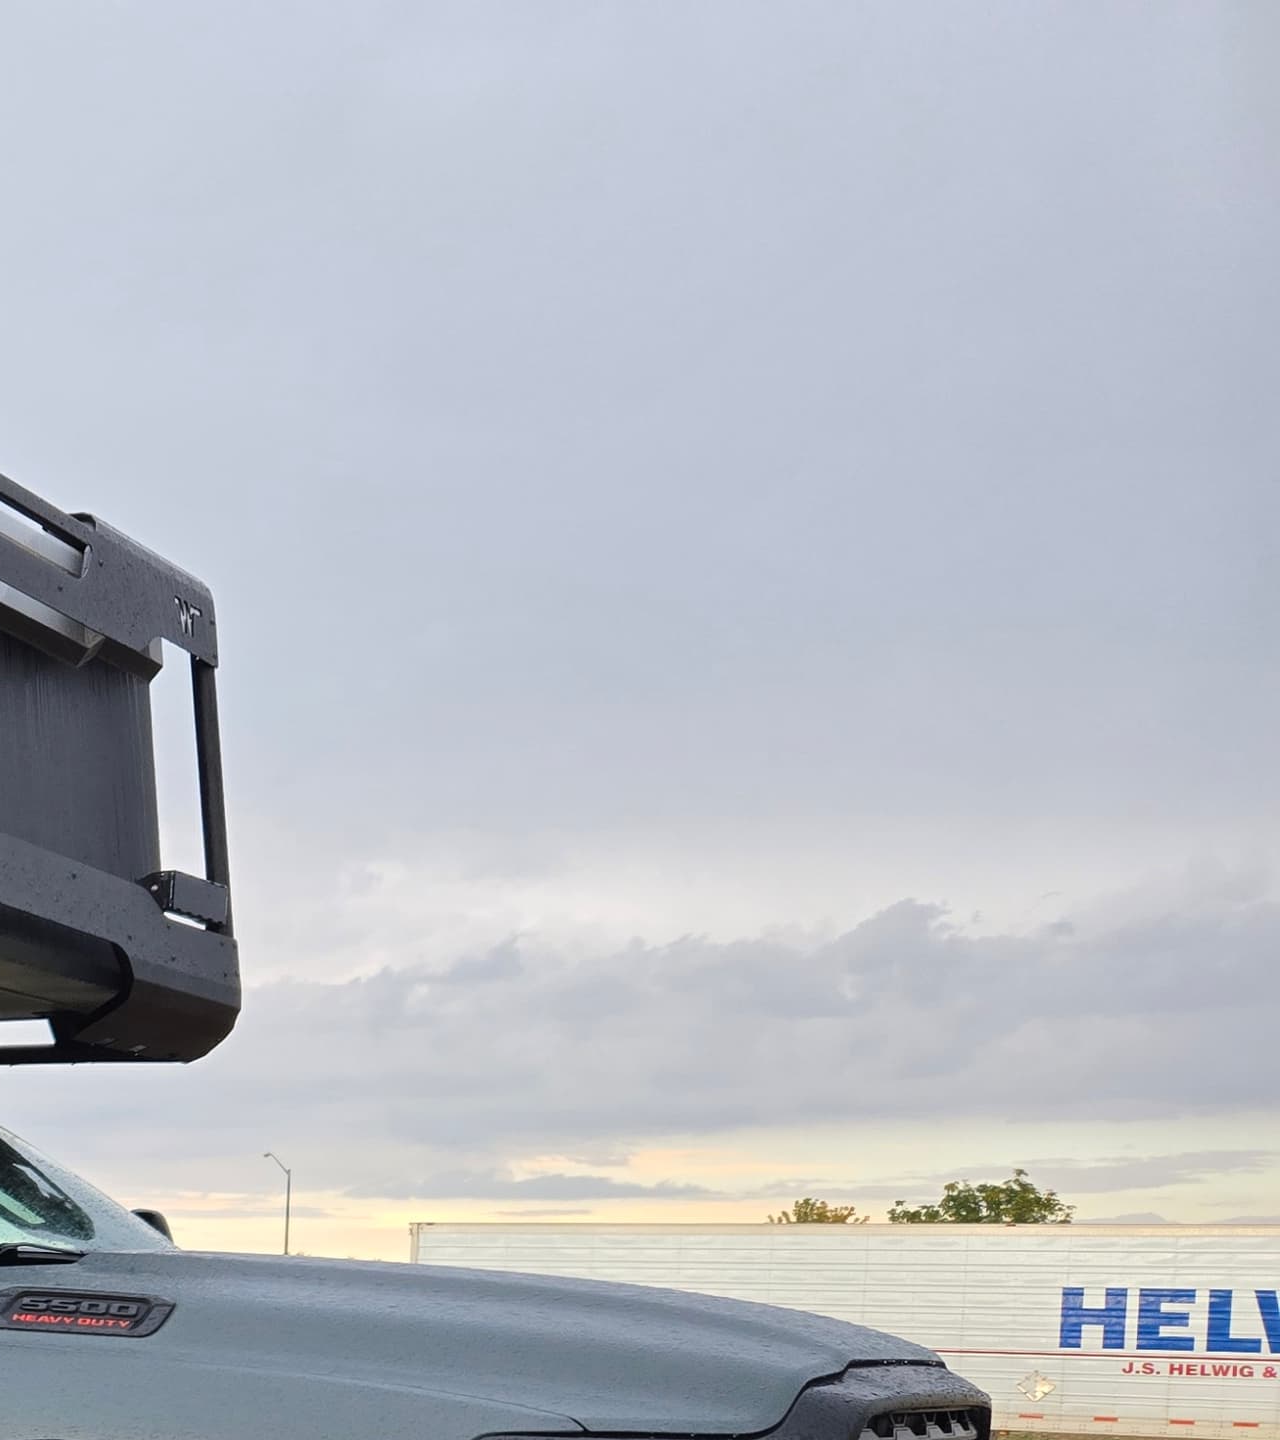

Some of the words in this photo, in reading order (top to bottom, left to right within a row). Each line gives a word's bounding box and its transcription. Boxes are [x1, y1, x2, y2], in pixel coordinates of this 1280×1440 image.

[20, 1297, 138, 1318] 5500
[12, 1312, 75, 1324] HEAVY
[77, 1316, 131, 1328] DUTY
[1059, 1286, 1280, 1354] HEL
[1122, 1362, 1161, 1376] J.S.
[1169, 1363, 1255, 1378] HELWIG
[1262, 1366, 1278, 1378] &
